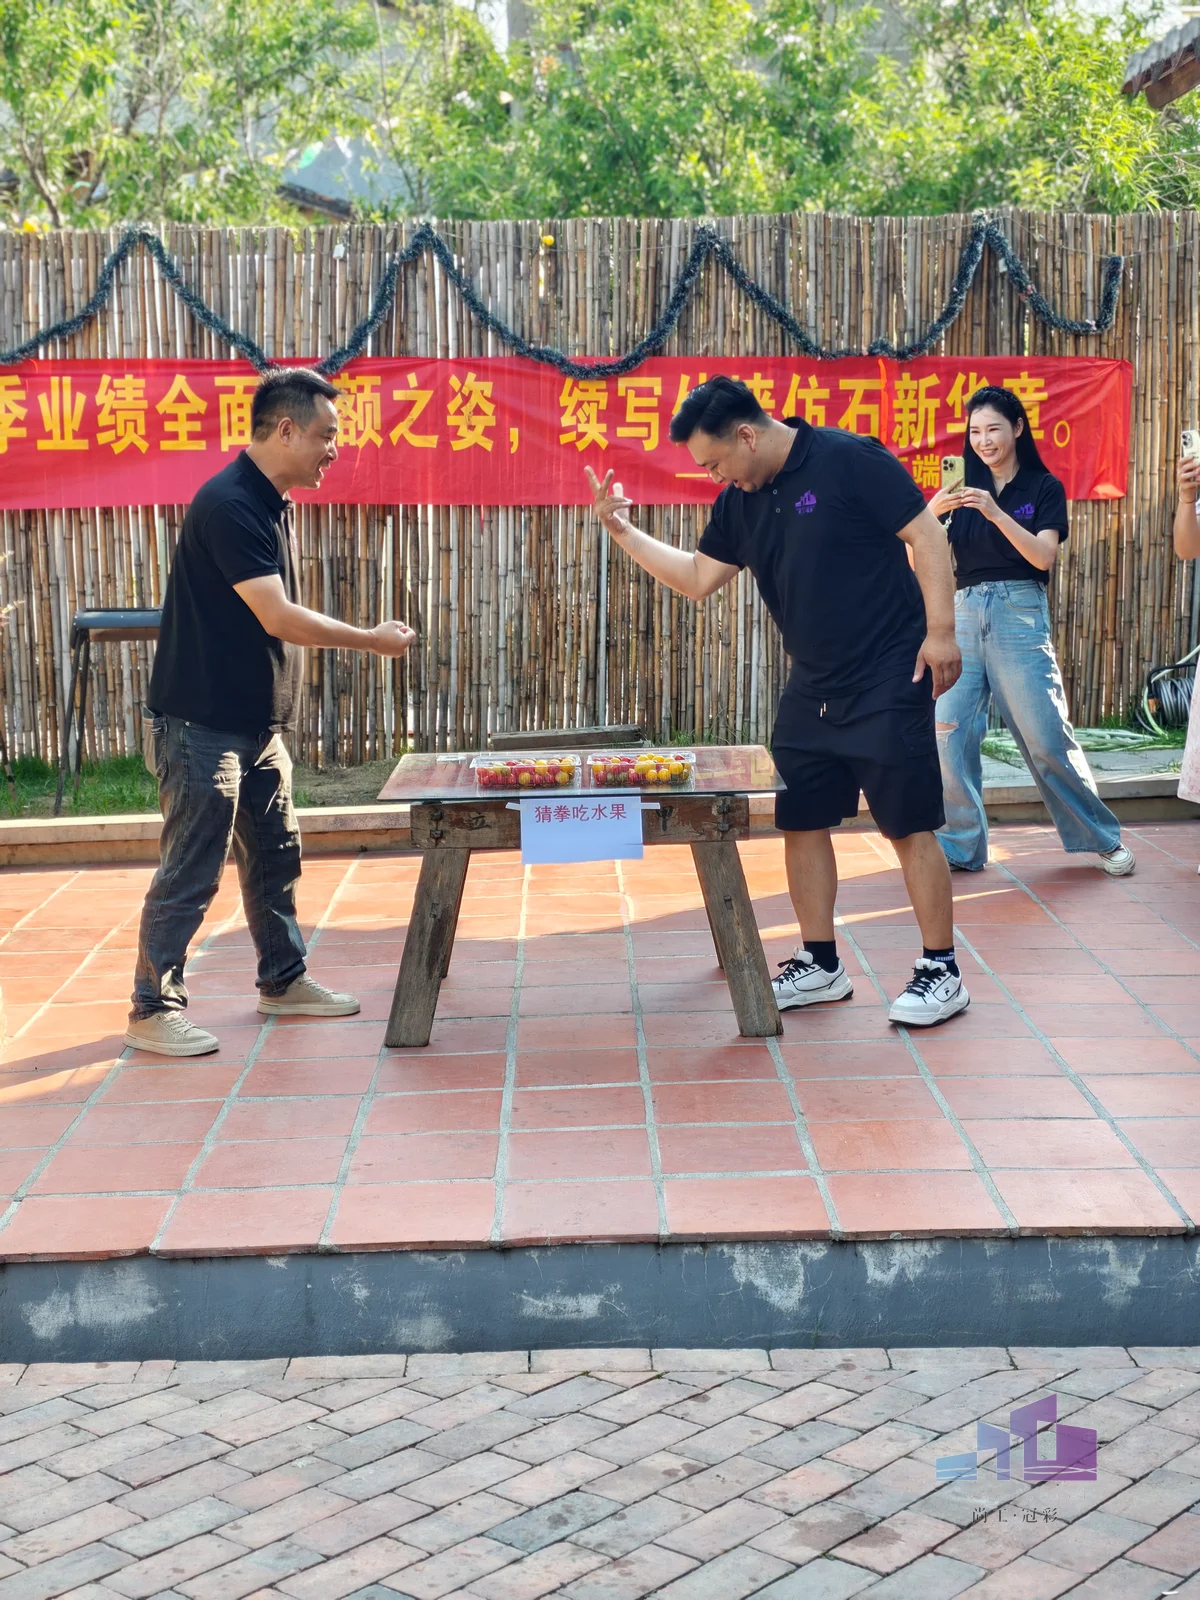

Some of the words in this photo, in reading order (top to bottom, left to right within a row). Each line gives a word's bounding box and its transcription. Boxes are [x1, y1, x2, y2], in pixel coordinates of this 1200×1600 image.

[534, 803, 627, 823] 猜拳吃水果
